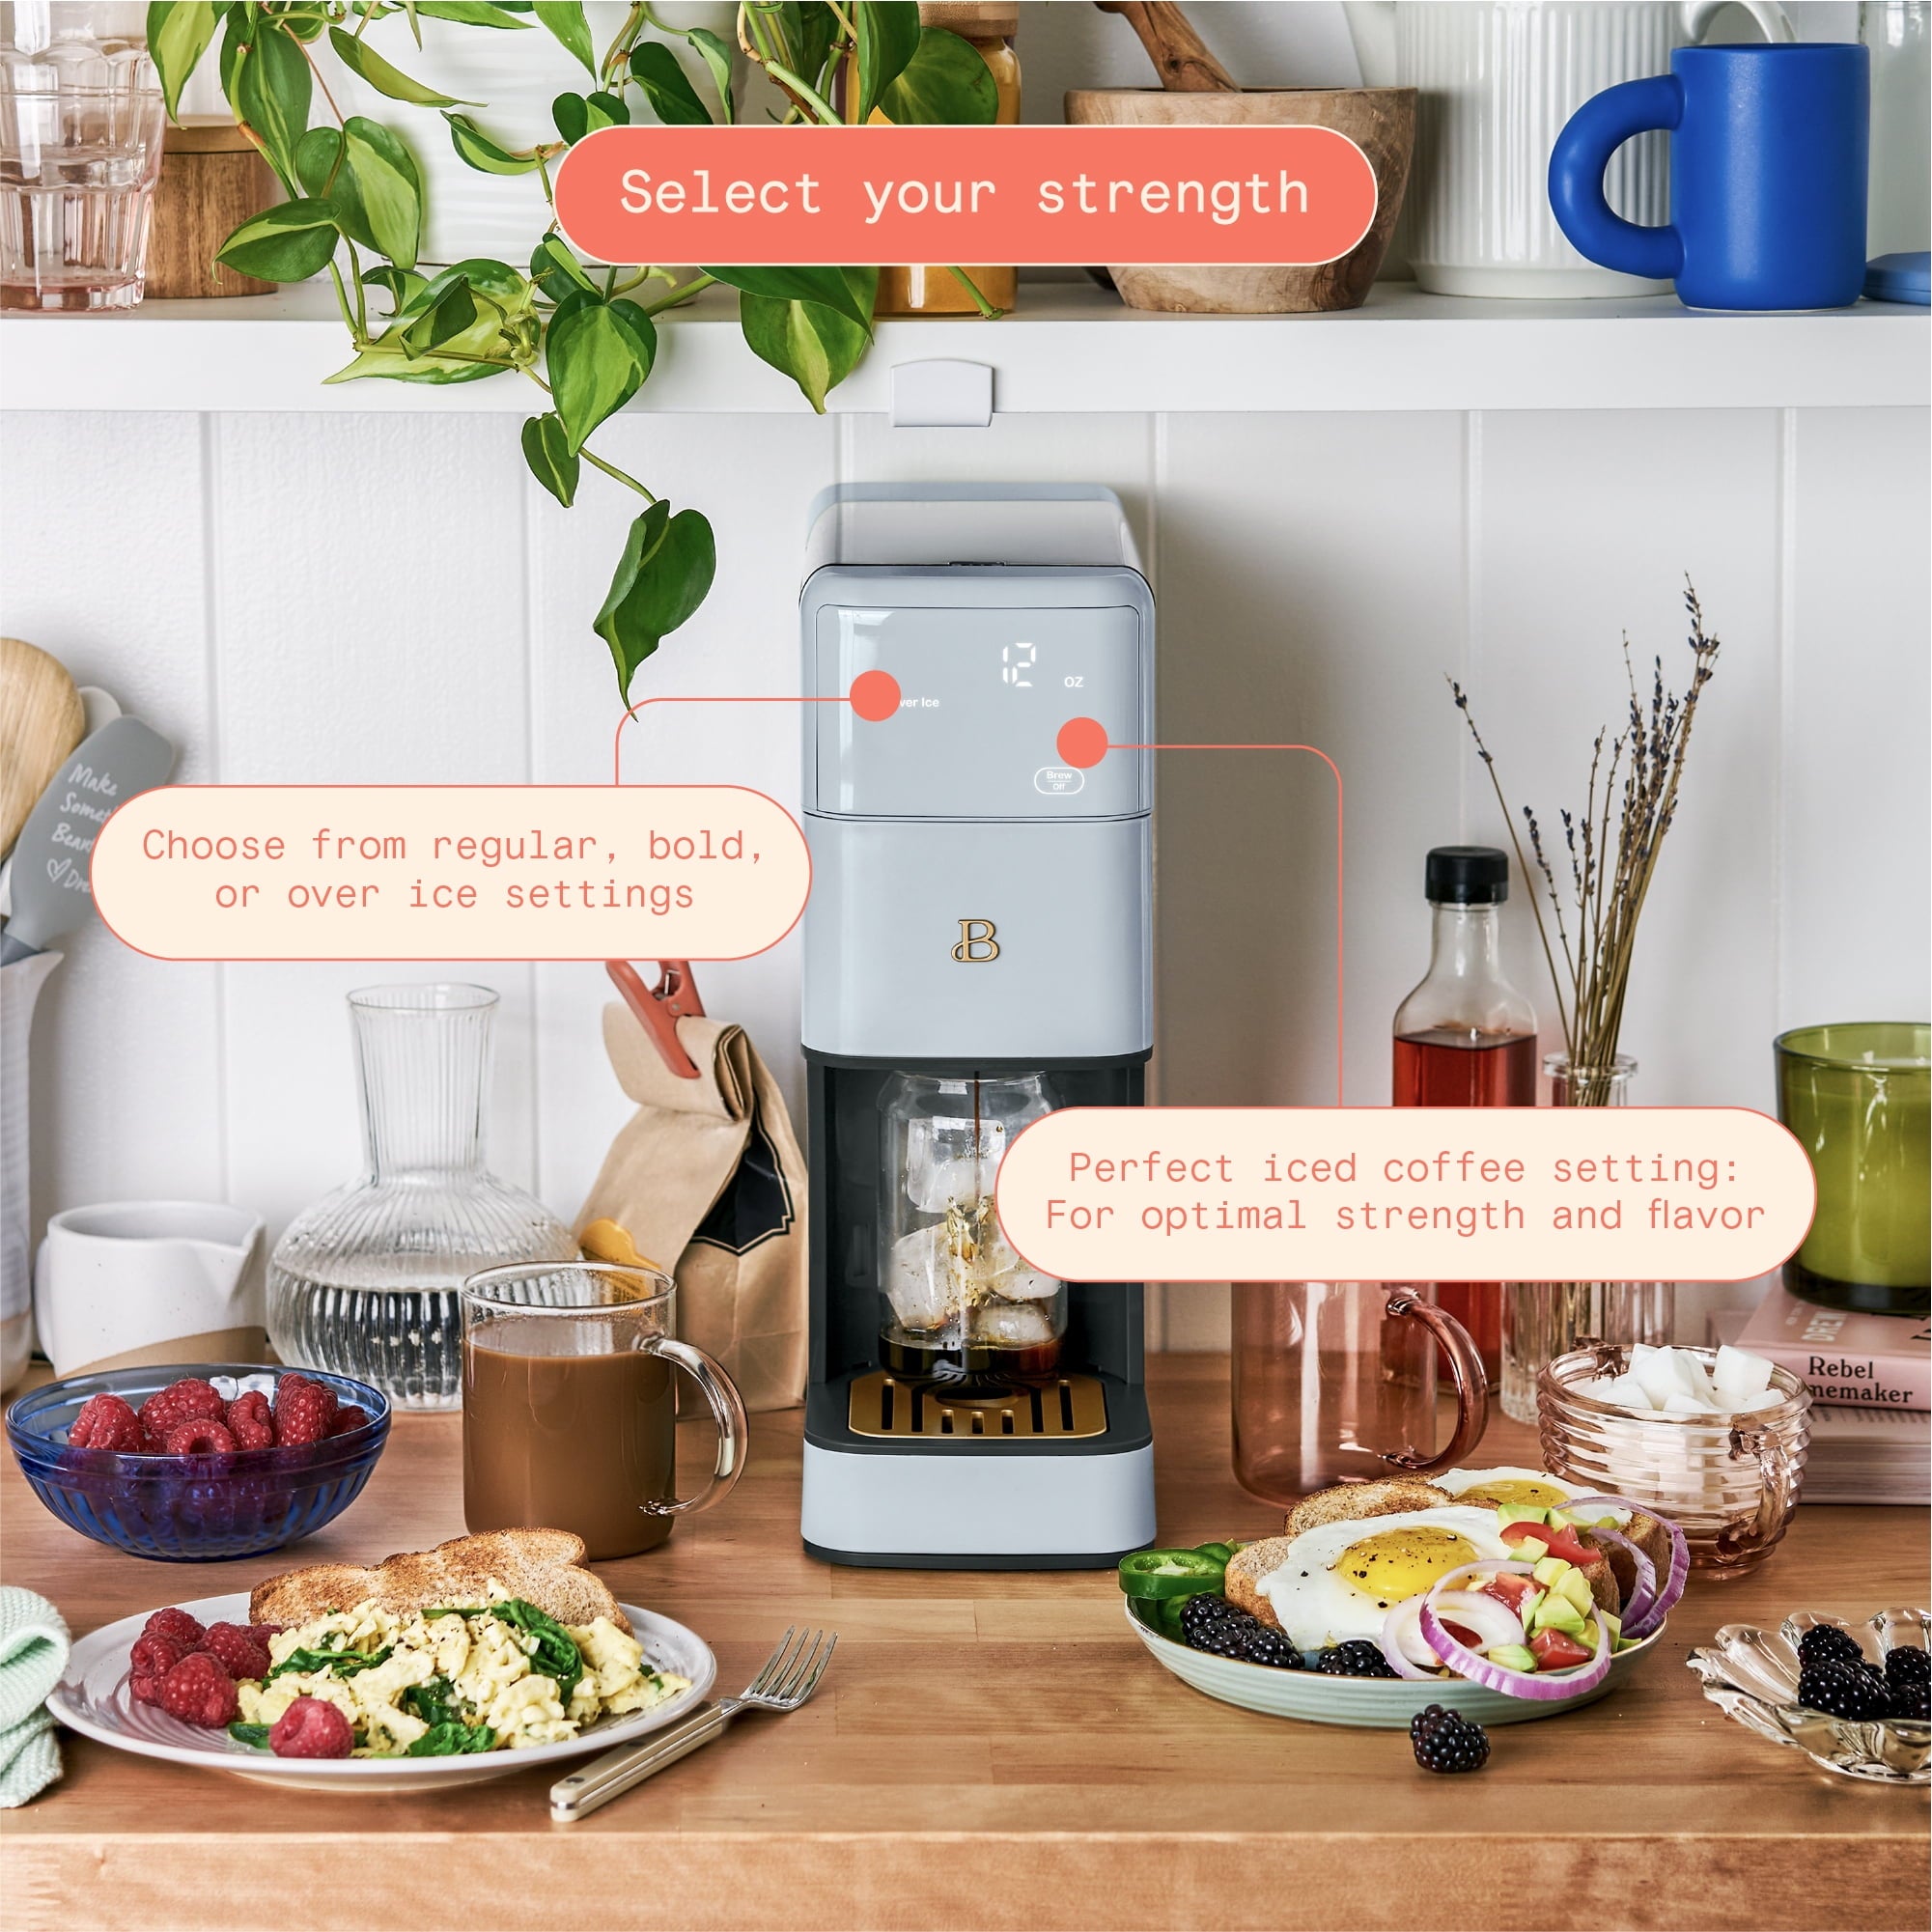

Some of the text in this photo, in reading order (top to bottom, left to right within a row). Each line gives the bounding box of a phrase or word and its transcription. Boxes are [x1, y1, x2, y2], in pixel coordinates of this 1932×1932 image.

[1002, 642, 1036, 687] 12
[900, 697, 939, 708] ver Ice
[68, 763, 117, 796] Make
[1047, 770, 1072, 779] Brew
[951, 918, 1000, 963] B
[1808, 1356, 1874, 1379] Rebel
